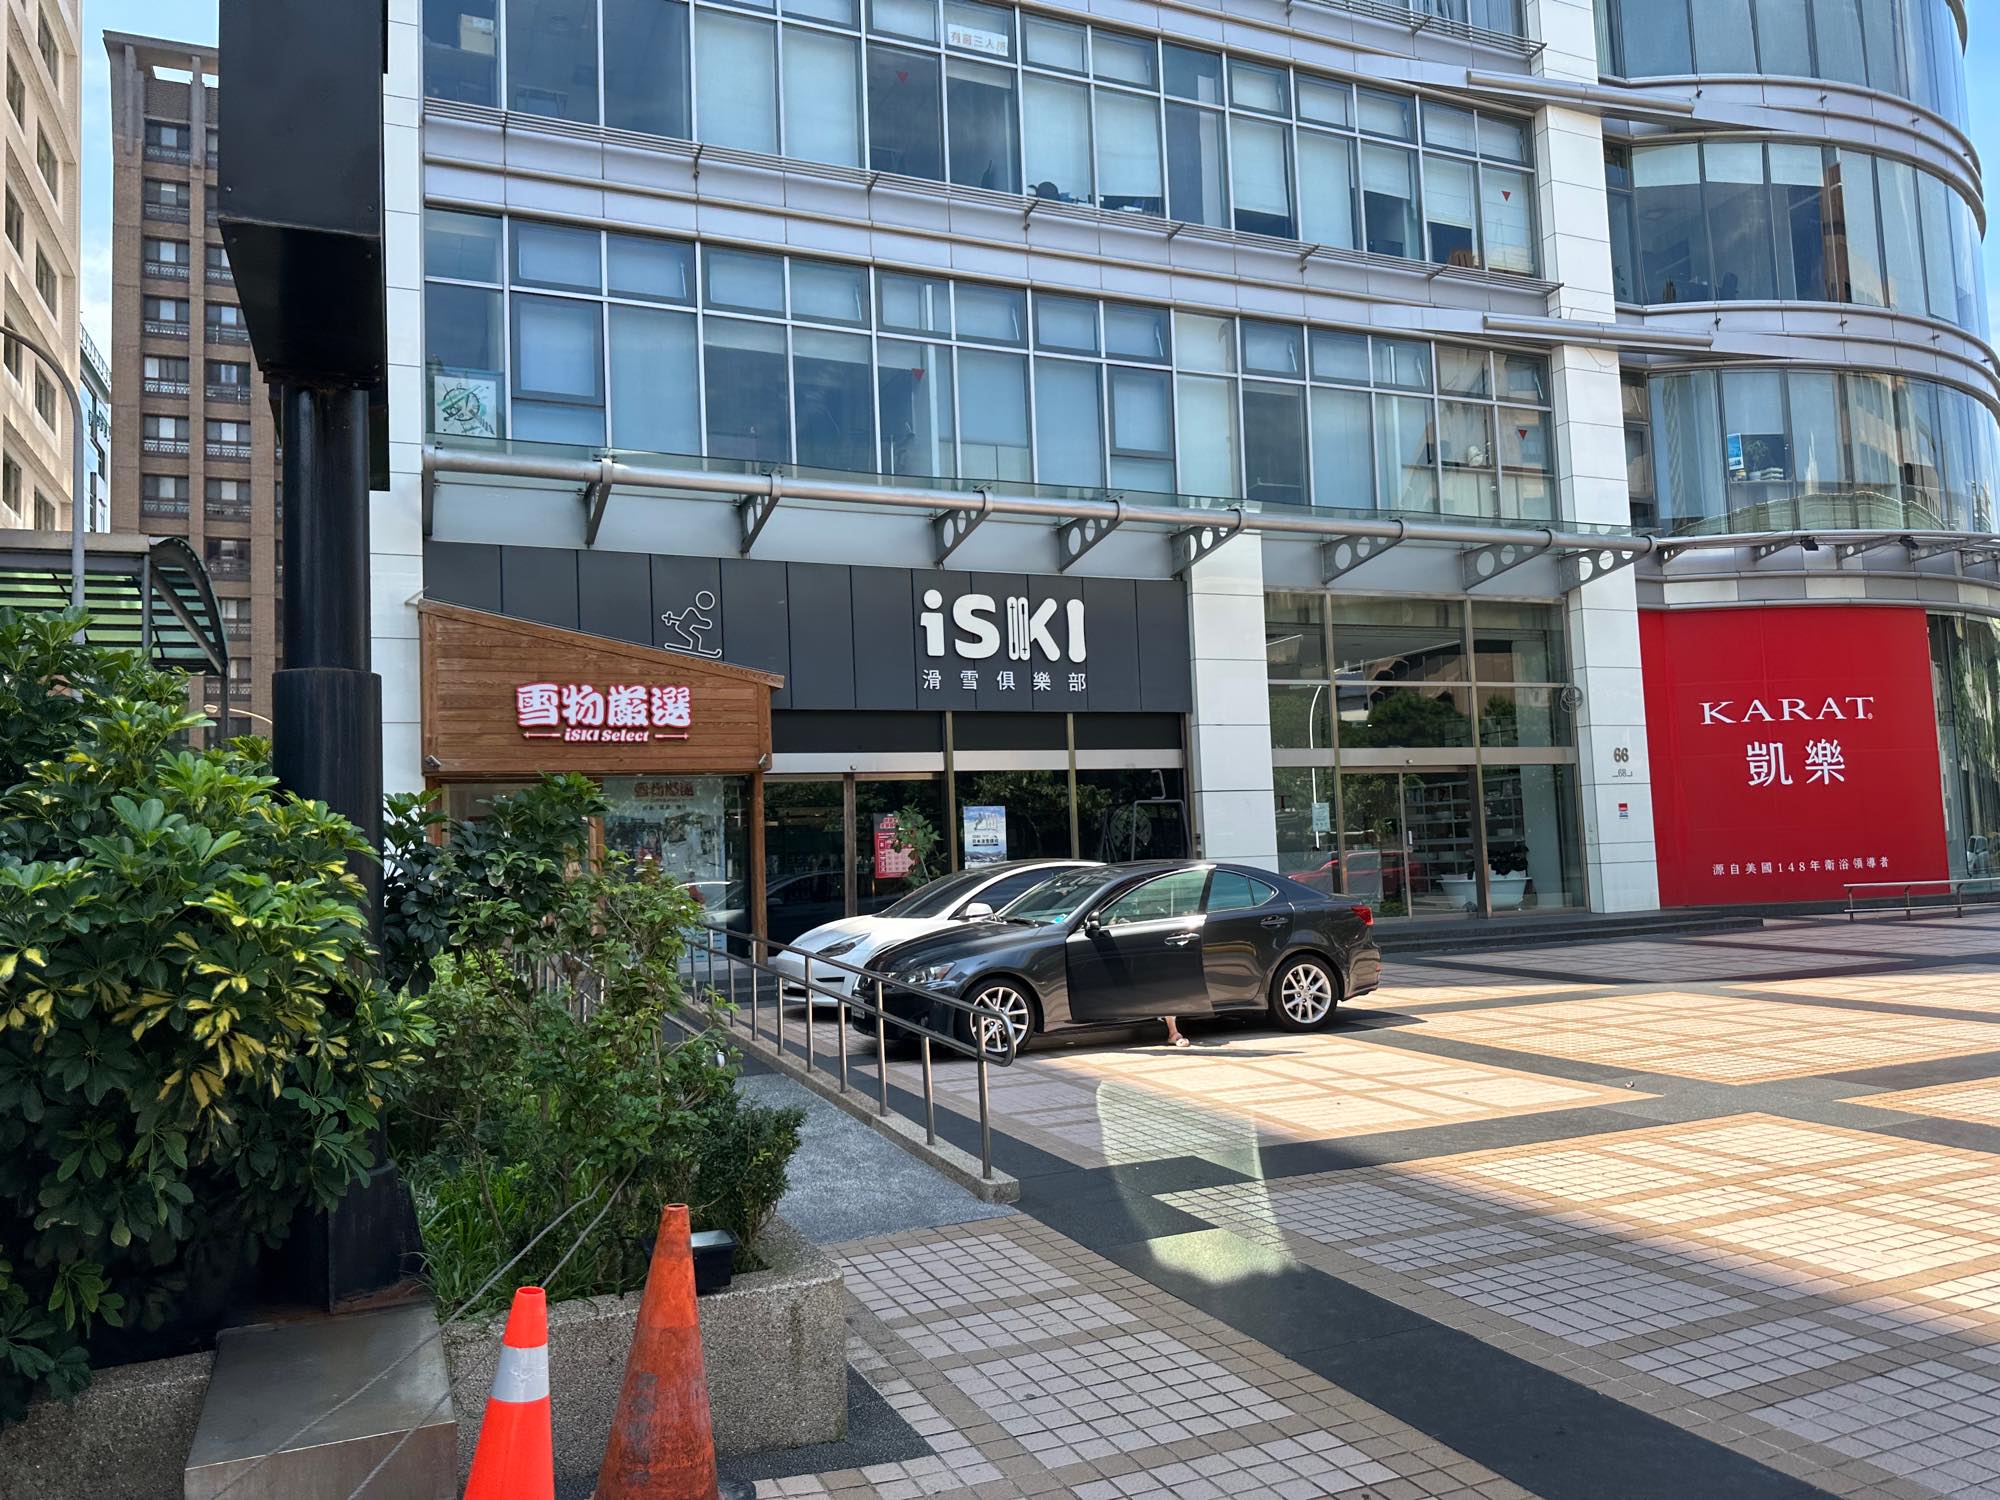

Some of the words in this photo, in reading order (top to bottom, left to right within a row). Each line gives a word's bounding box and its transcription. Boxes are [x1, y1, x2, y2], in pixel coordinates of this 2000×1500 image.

[920, 589, 1087, 663] iSKI
[922, 669, 1087, 692] 滑雪俱樂部
[564, 727, 599, 742] iSKI
[600, 729, 649, 742] Select
[1613, 747, 1629, 763] 66
[1746, 738, 1845, 787] 凱樂
